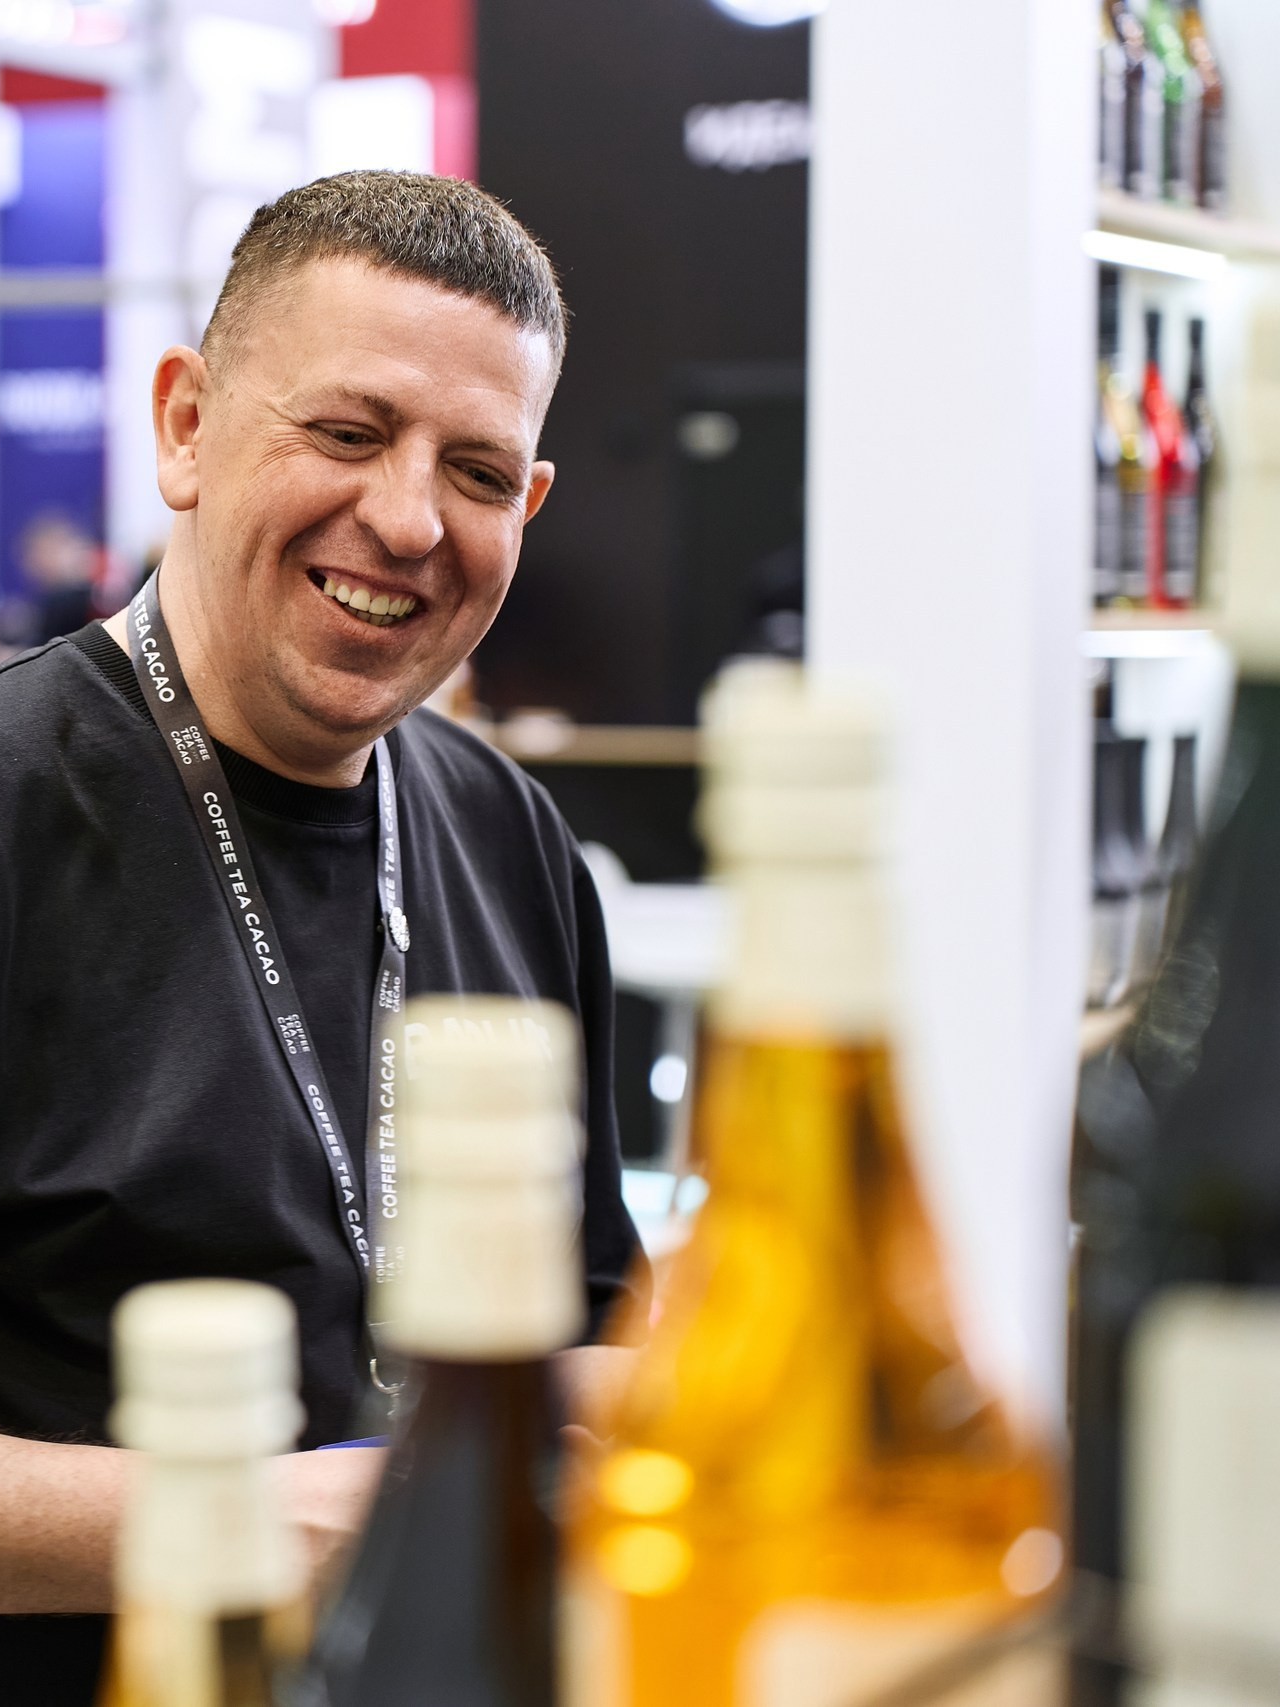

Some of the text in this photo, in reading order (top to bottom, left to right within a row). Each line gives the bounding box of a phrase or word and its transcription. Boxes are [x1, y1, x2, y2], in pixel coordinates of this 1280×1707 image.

[134, 602, 152, 639] TEA
[141, 637, 175, 703] CACAO
[170, 730, 192, 765] CACAO
[180, 727, 195, 748] TEA
[189, 725, 211, 761] COFFEE
[381, 764, 394, 833] CACAO
[384, 837, 396, 873] TEA
[203, 791, 280, 985] COFFEE TEA CACAO
[277, 1016, 297, 1054] CACAO
[284, 1014, 298, 1037] TEA
[290, 1013, 311, 1052] COFFEE
[307, 1084, 343, 1157] COFFEE
[337, 1162, 356, 1204] TEA
[379, 1038, 399, 1219] COFFEE TEA CACAO
